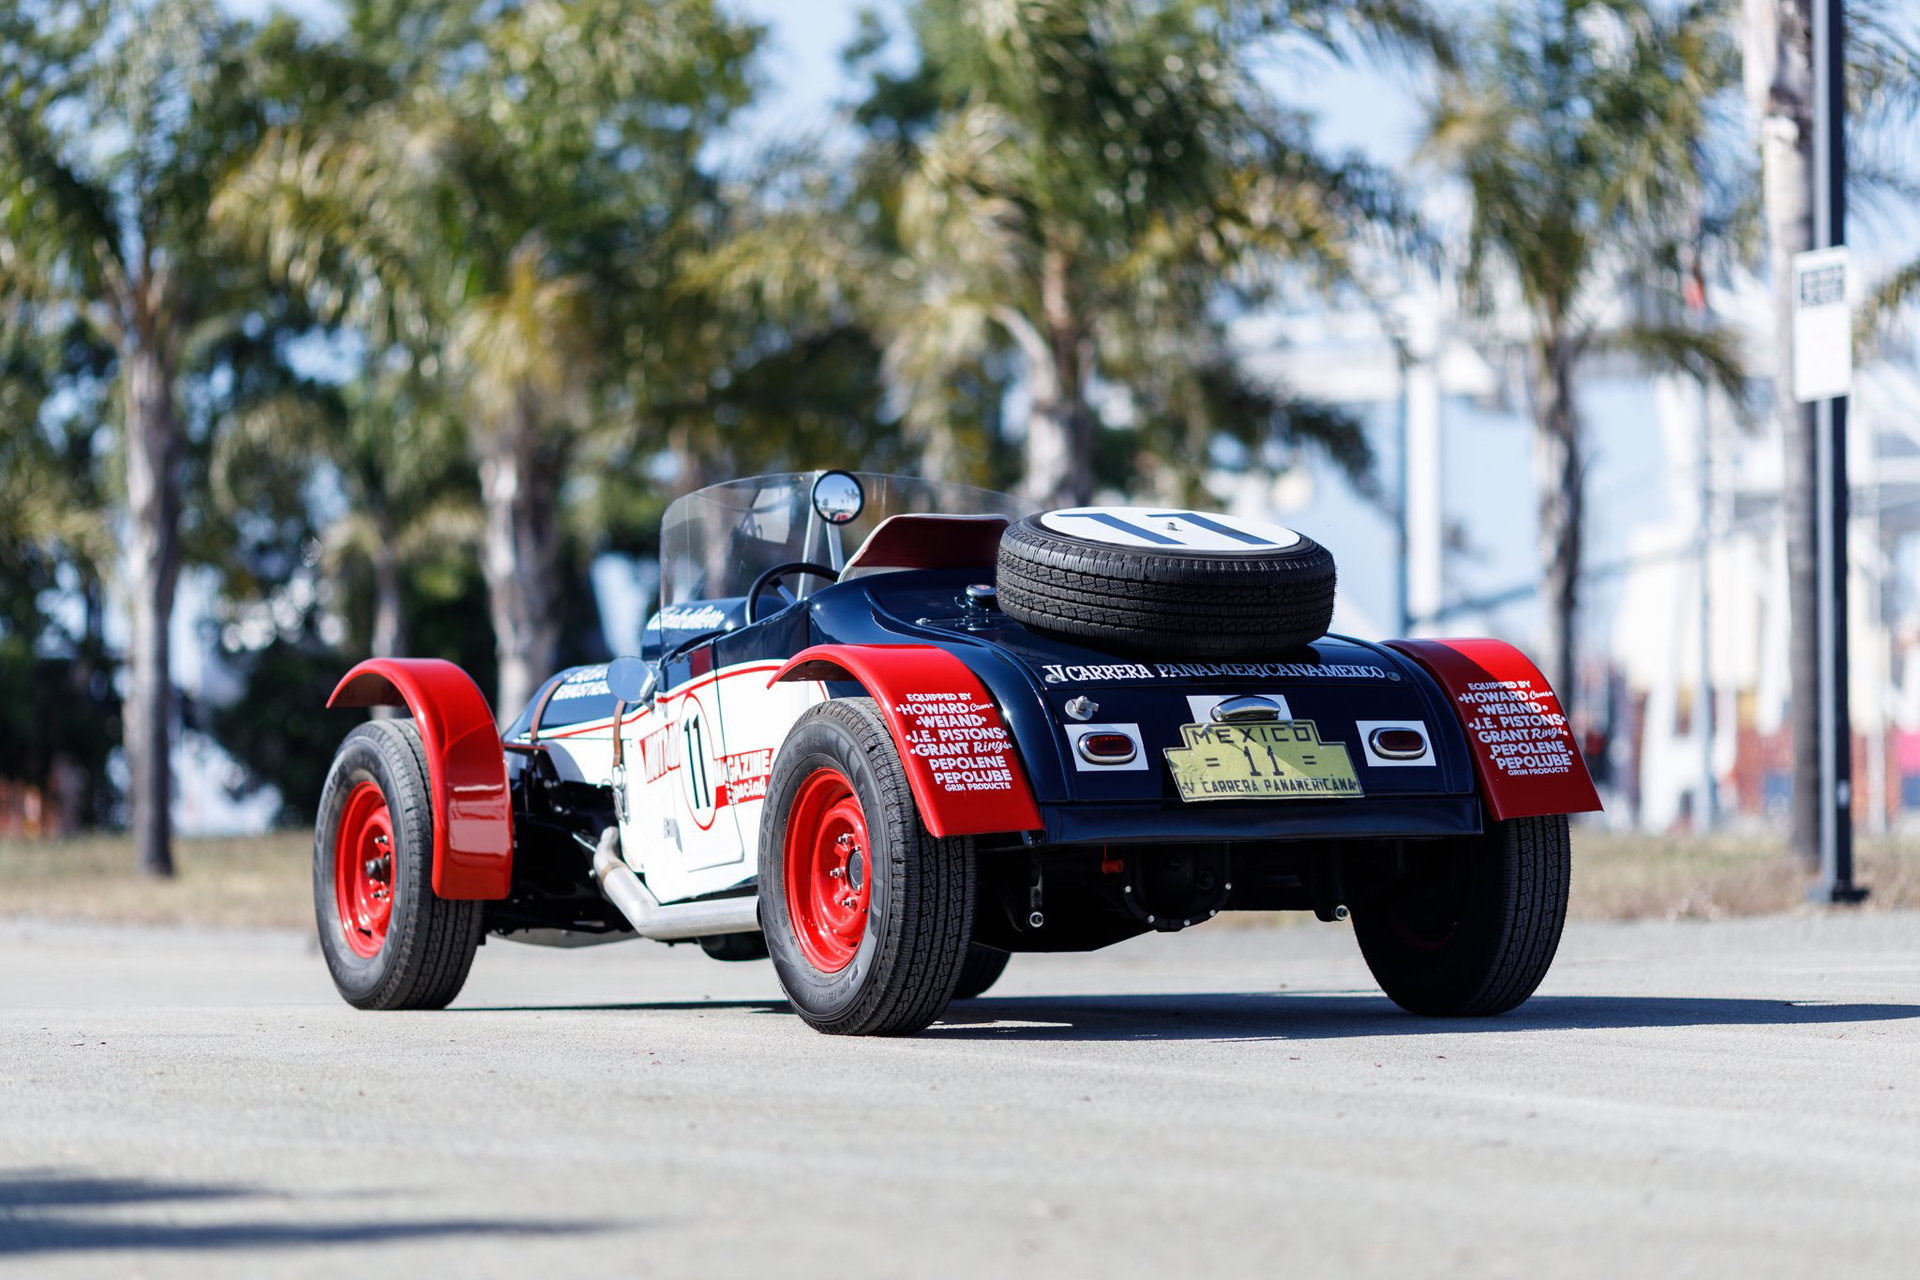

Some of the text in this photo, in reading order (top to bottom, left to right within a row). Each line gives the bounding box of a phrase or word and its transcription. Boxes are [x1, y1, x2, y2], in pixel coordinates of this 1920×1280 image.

[1065, 663, 1155, 682] CARRERA
[1467, 680, 1531, 691] EQUIPPED BY
[906, 692, 972, 702] EQUIPPED BY
[1461, 690, 1529, 704] HOWARD
[899, 703, 970, 715] HOWARD
[1481, 702, 1543, 715] WEIAND
[920, 714, 982, 728] WEIAND
[1473, 713, 1564, 731] J.E. PISTONS
[911, 727, 1004, 743] J.E. PISTONS
[1191, 726, 1313, 745] MEXICO
[1478, 727, 1563, 743] GRANT Rings
[915, 741, 1009, 757] GRANT Rings
[1489, 740, 1567, 757] PEPOLENE
[683, 714, 711, 809] 11
[928, 756, 1007, 771] PEPOLENE
[1496, 753, 1572, 770] PEPOLUBE
[934, 769, 1013, 784] PEPOLUBE
[1529, 767, 1569, 776] PRODUCTS
[944, 781, 1011, 791] GRIN PRODUCTS
[1201, 780, 1259, 793] CARRERA
